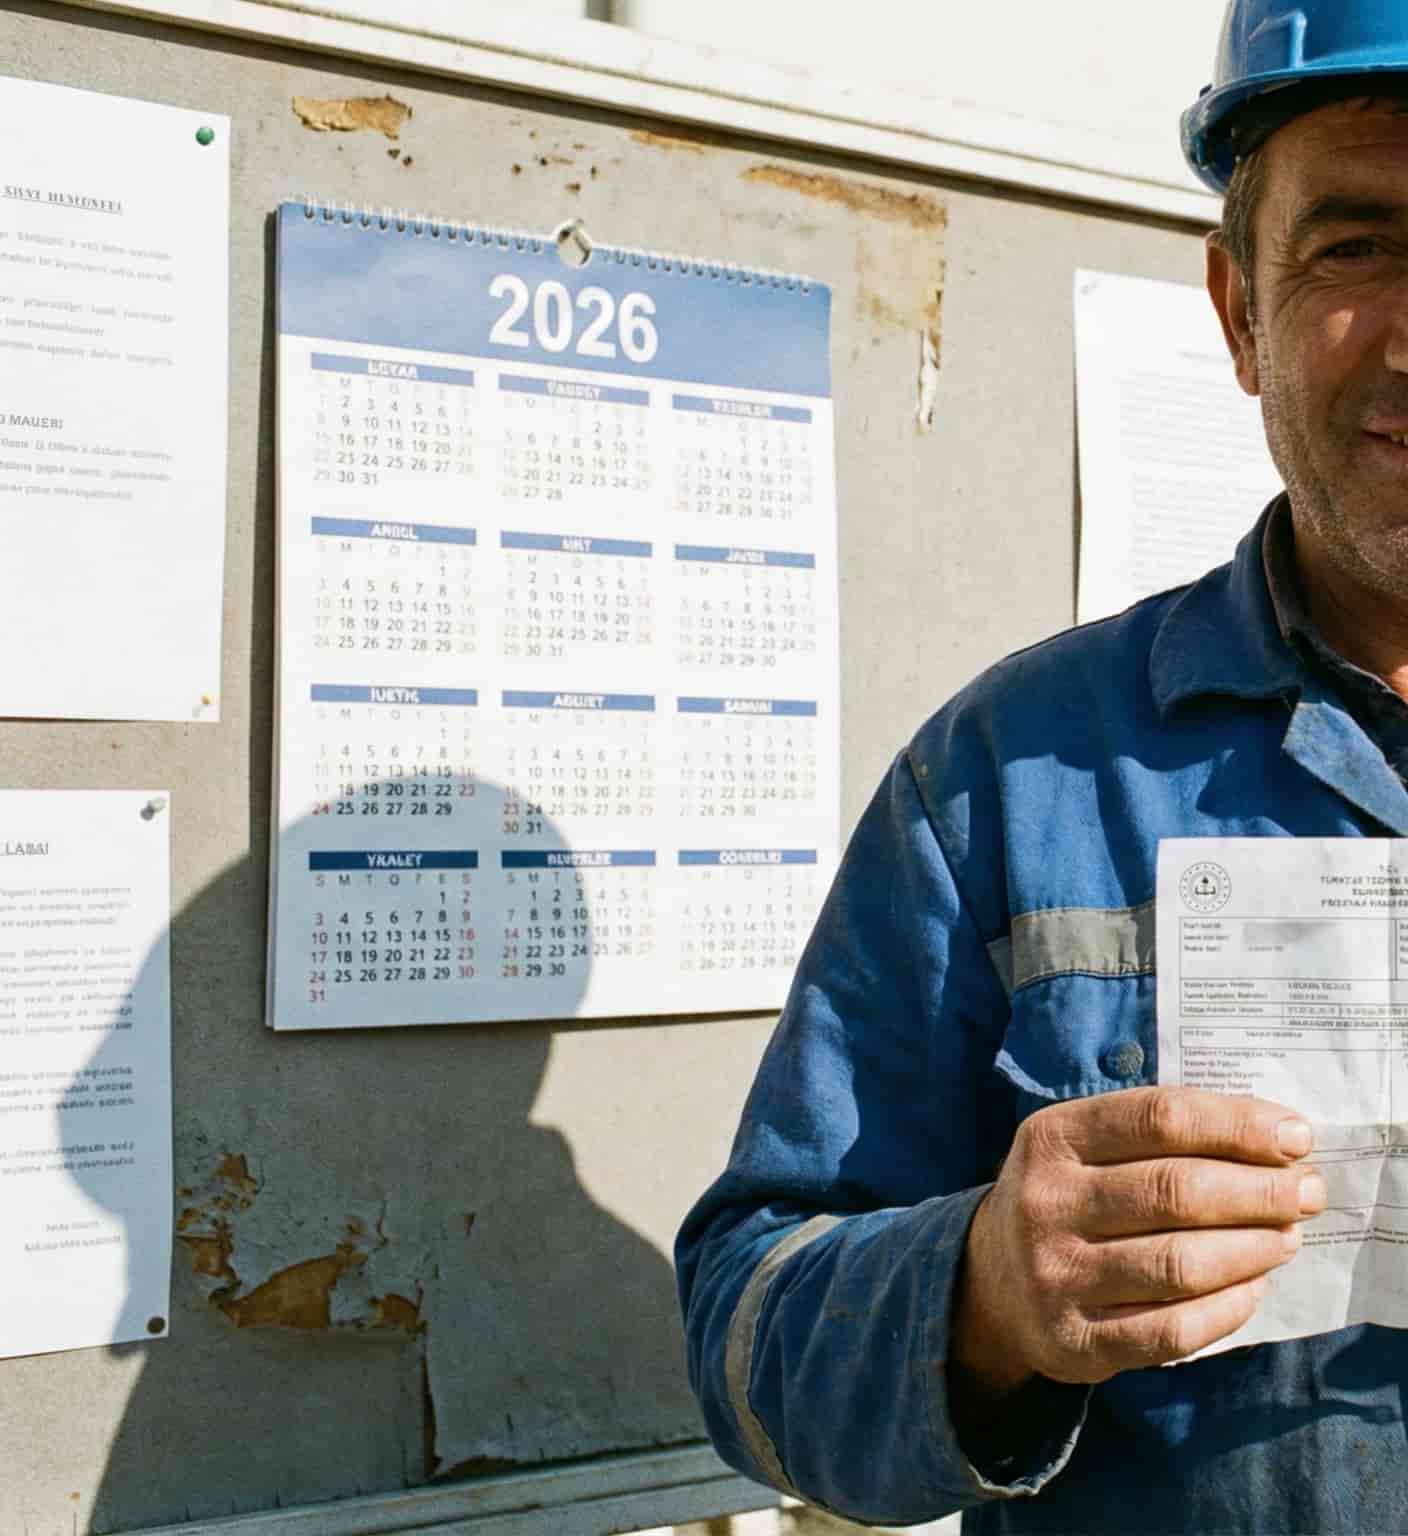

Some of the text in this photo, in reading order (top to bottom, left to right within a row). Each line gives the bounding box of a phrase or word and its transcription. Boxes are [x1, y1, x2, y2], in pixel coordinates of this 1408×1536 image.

[488, 273, 659, 363] 2026
[340, 784, 354, 796] 18
[364, 783, 379, 796] 19
[387, 783, 403, 796] 20
[411, 784, 426, 797] 21
[434, 784, 451, 797] 22
[337, 801, 354, 815] 25
[362, 802, 379, 815] 26
[386, 802, 403, 815] 27
[411, 802, 428, 815] 28
[435, 802, 452, 815] 29
[573, 907, 588, 920] 10
[336, 931, 351, 944] 11
[362, 931, 378, 944] 12
[386, 930, 402, 943] 13
[411, 929, 426, 942] 14
[435, 928, 451, 942] 15
[528, 926, 542, 939] 15
[550, 926, 565, 939] 16
[572, 924, 588, 938] 17
[336, 950, 352, 964] 18
[361, 950, 378, 963] 19
[385, 949, 402, 963] 20
[409, 949, 424, 961] 21
[434, 948, 450, 960] 22
[526, 945, 542, 959] 22
[548, 944, 565, 958] 23
[571, 944, 589, 957] 24
[334, 969, 352, 983] 25
[360, 968, 377, 982] 26
[384, 968, 402, 981] 27
[408, 968, 426, 980] 28
[433, 967, 450, 980] 29
[526, 964, 542, 976] 29
[549, 962, 566, 976] 30
